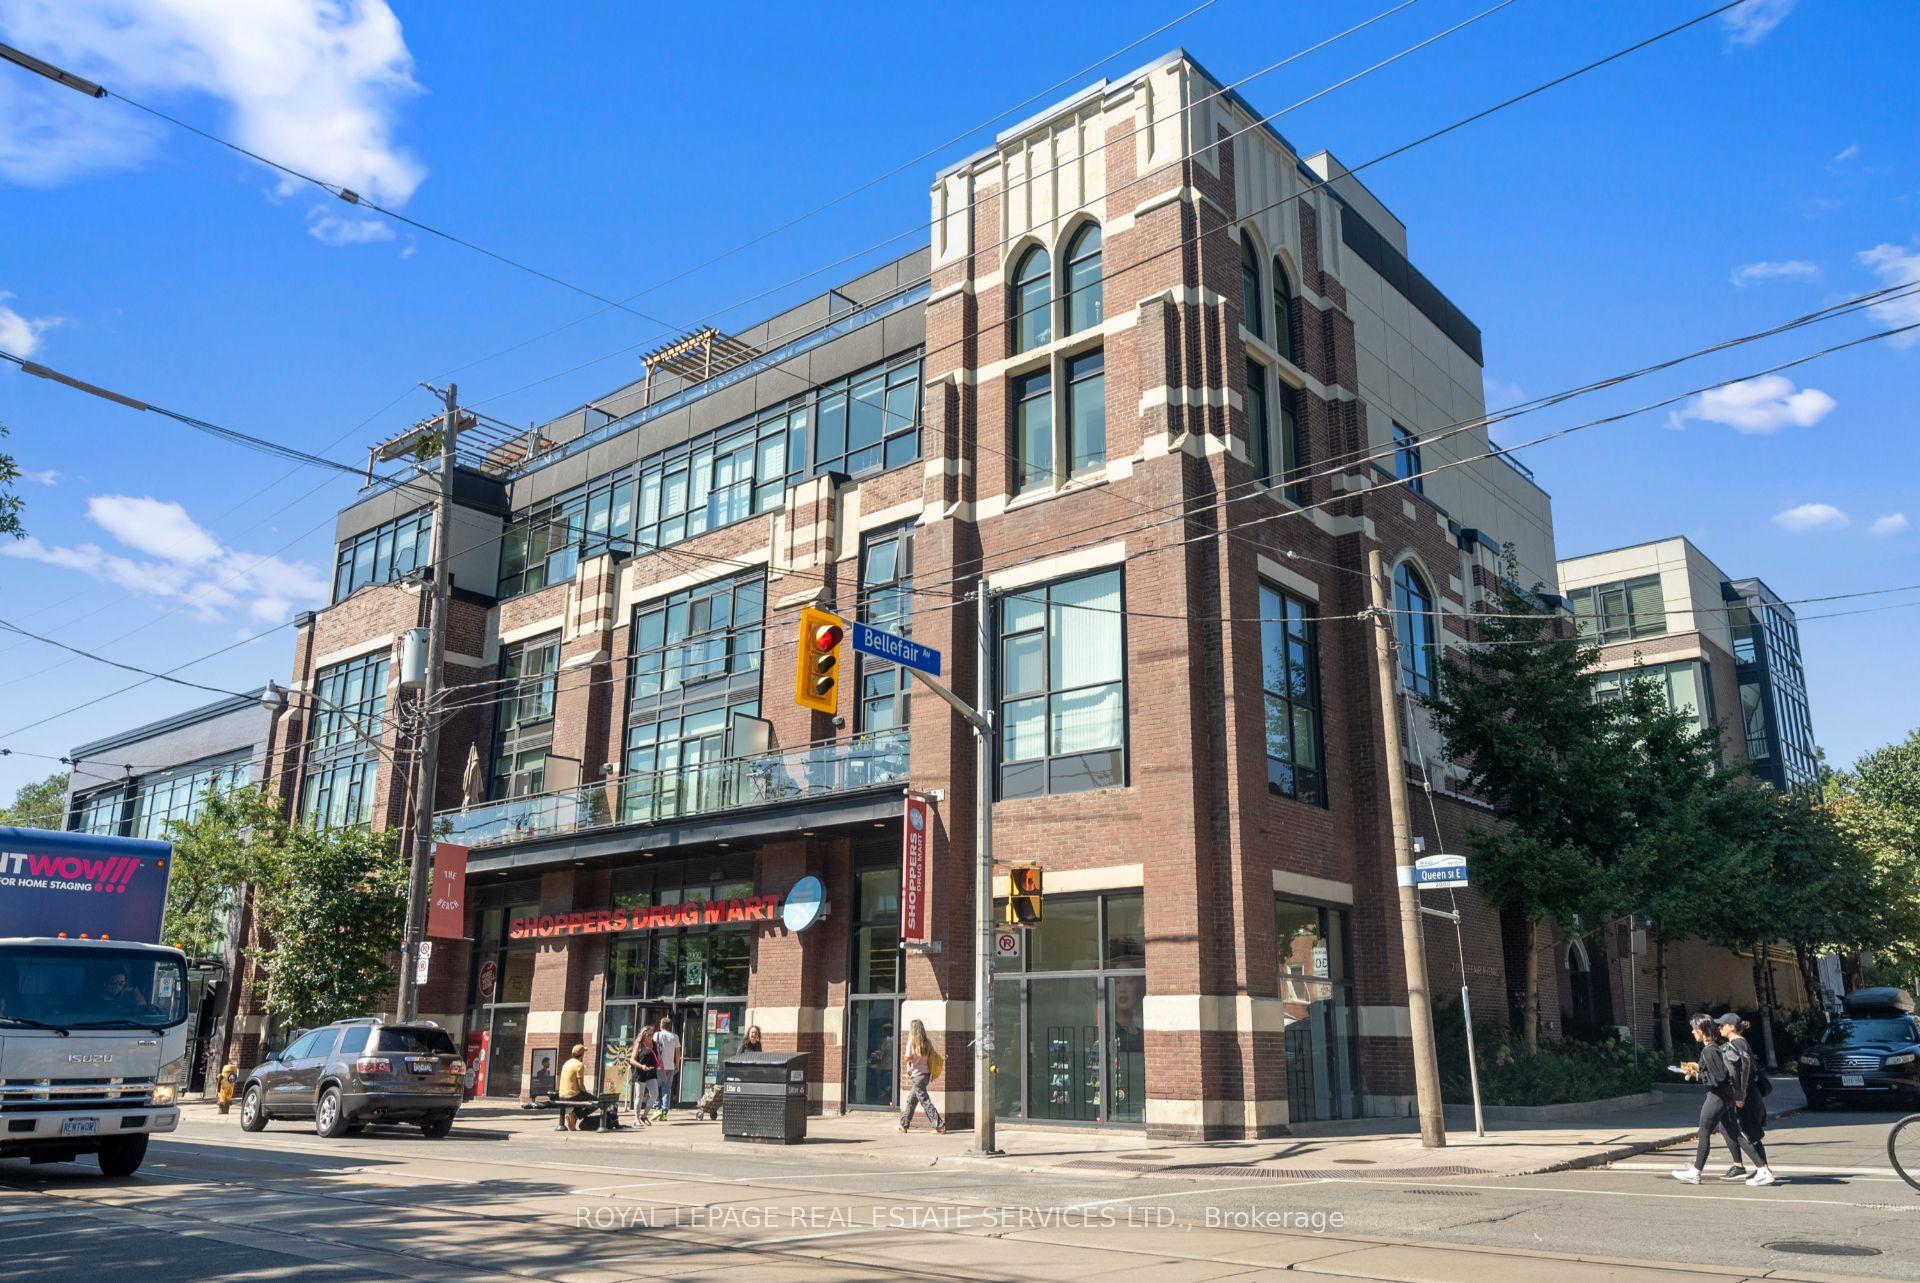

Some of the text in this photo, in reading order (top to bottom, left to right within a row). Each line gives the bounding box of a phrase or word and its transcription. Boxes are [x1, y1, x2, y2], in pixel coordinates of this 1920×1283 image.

[864, 629, 919, 662] Bellefair
[444, 870, 457, 880] THE
[908, 832, 917, 930] SHOPPERS
[1421, 870, 1447, 881] Queen
[1456, 868, 1461, 878] E
[18, 878, 48, 889] HOME
[49, 880, 92, 892] STAGING
[436, 898, 460, 911] BEACH
[509, 894, 781, 940] SHOPPERS DRUG MART
[68, 1054, 113, 1064] ISUZU
